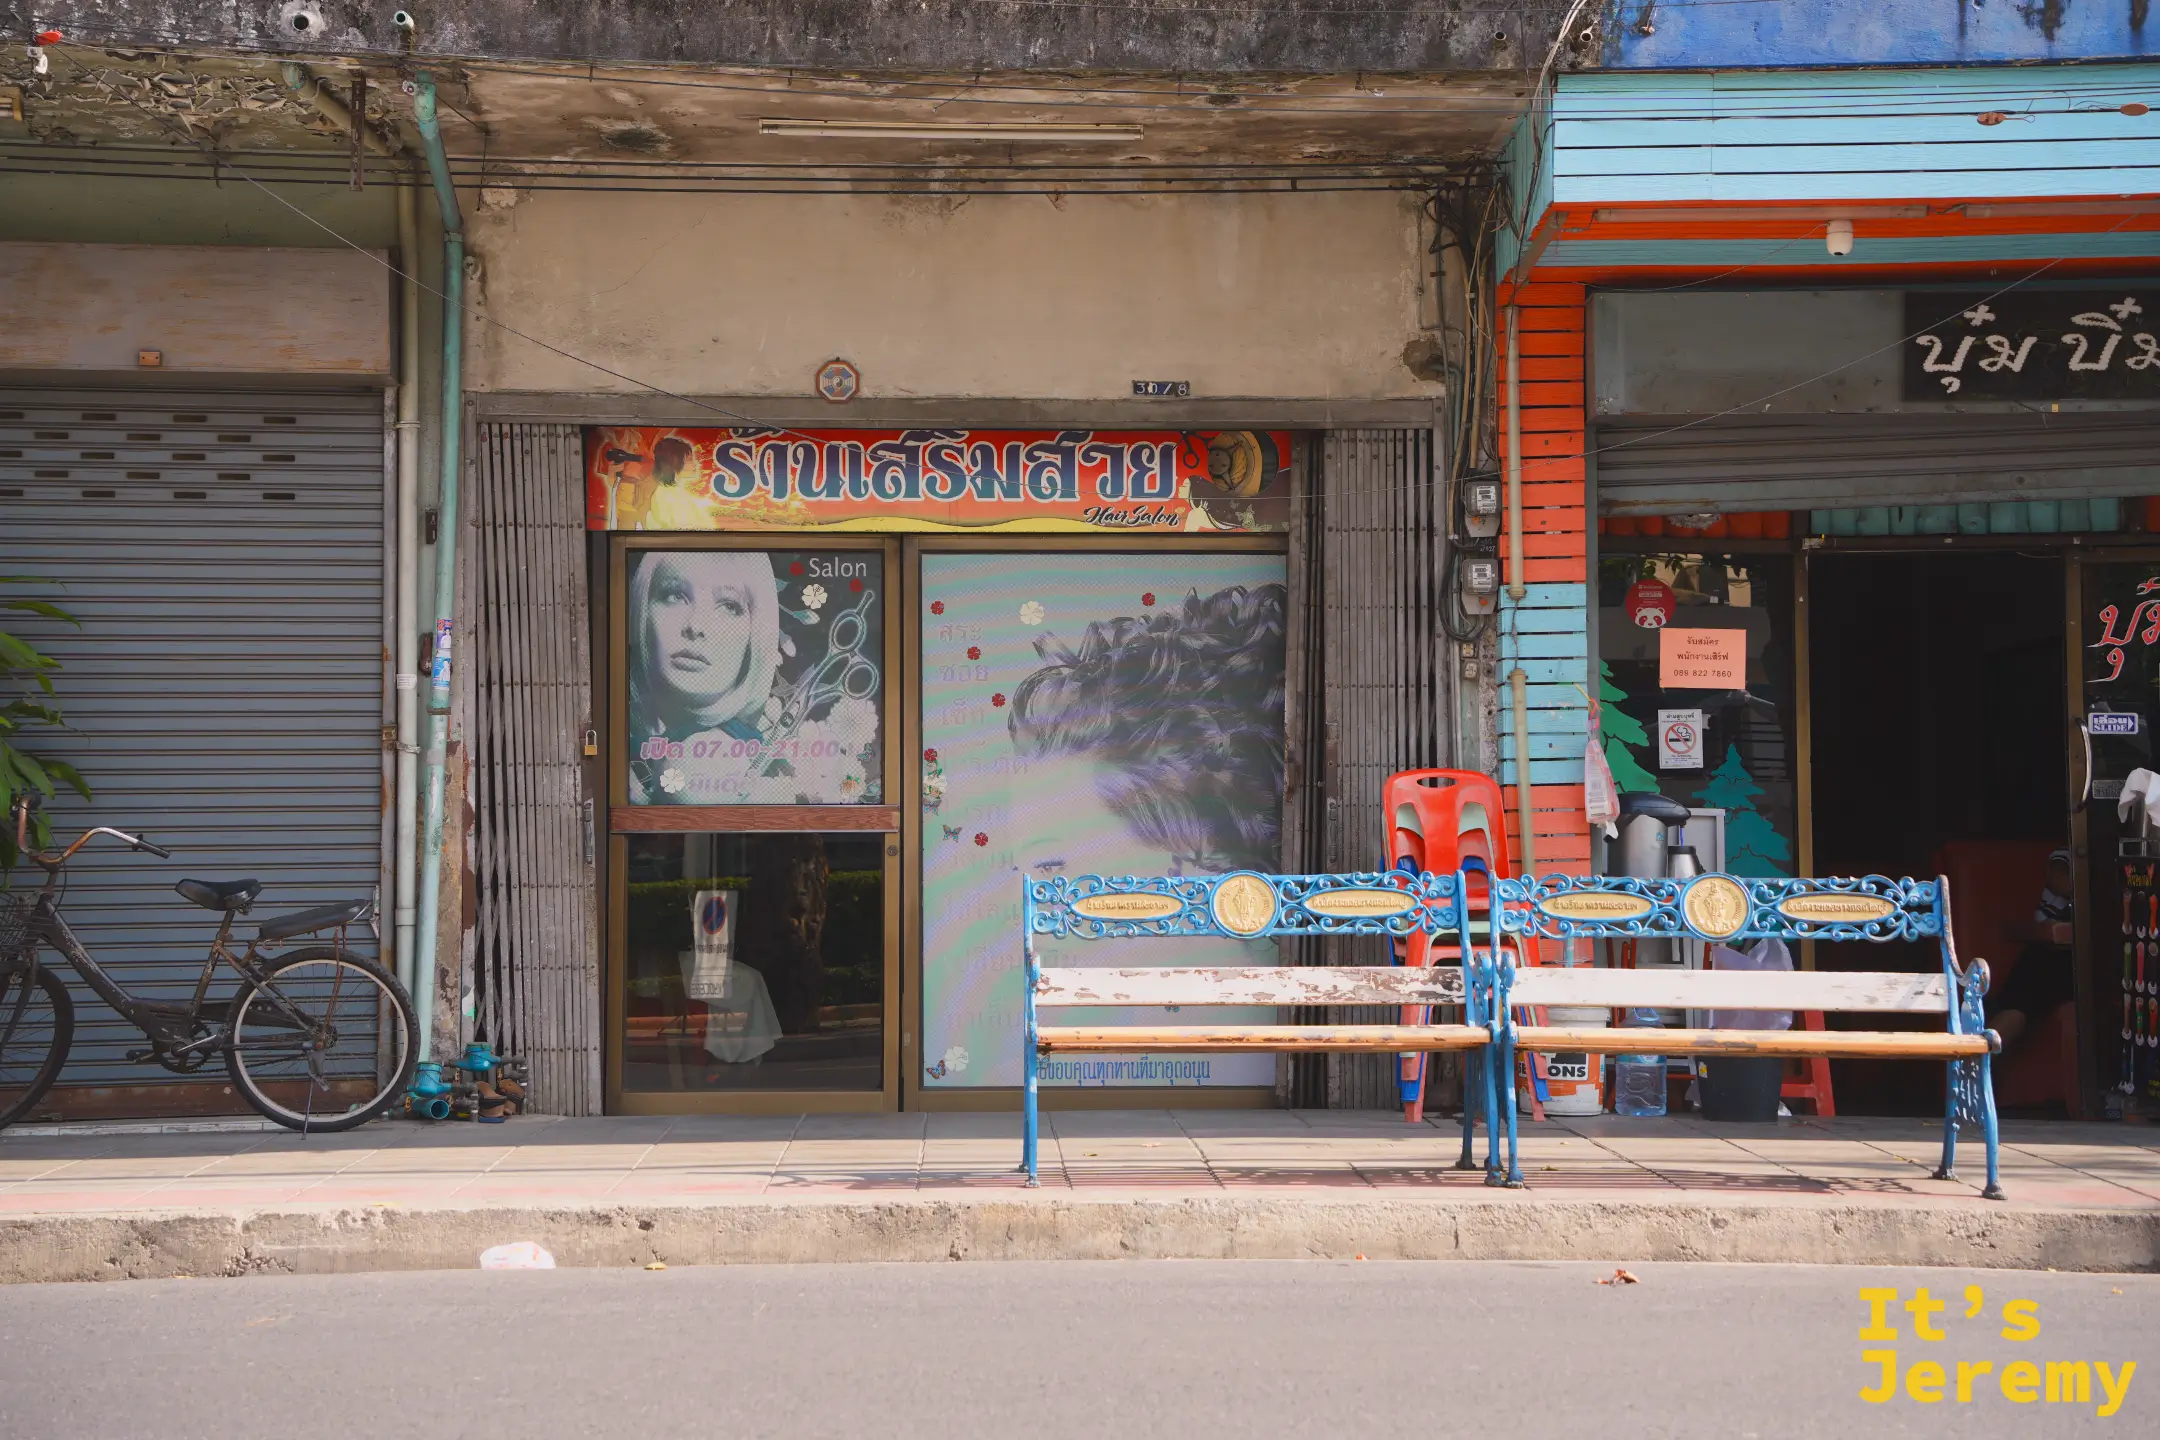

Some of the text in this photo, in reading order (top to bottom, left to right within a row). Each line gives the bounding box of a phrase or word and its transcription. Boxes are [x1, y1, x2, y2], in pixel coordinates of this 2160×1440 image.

[1915, 304, 2039, 394] บุ๋ม
[712, 428, 1178, 502] ร้านเสริมสวย
[1083, 505, 1179, 527] Hair Salon
[808, 557, 867, 578] Salon
[1711, 669, 1732, 678] 7860
[640, 737, 685, 760] เปิด
